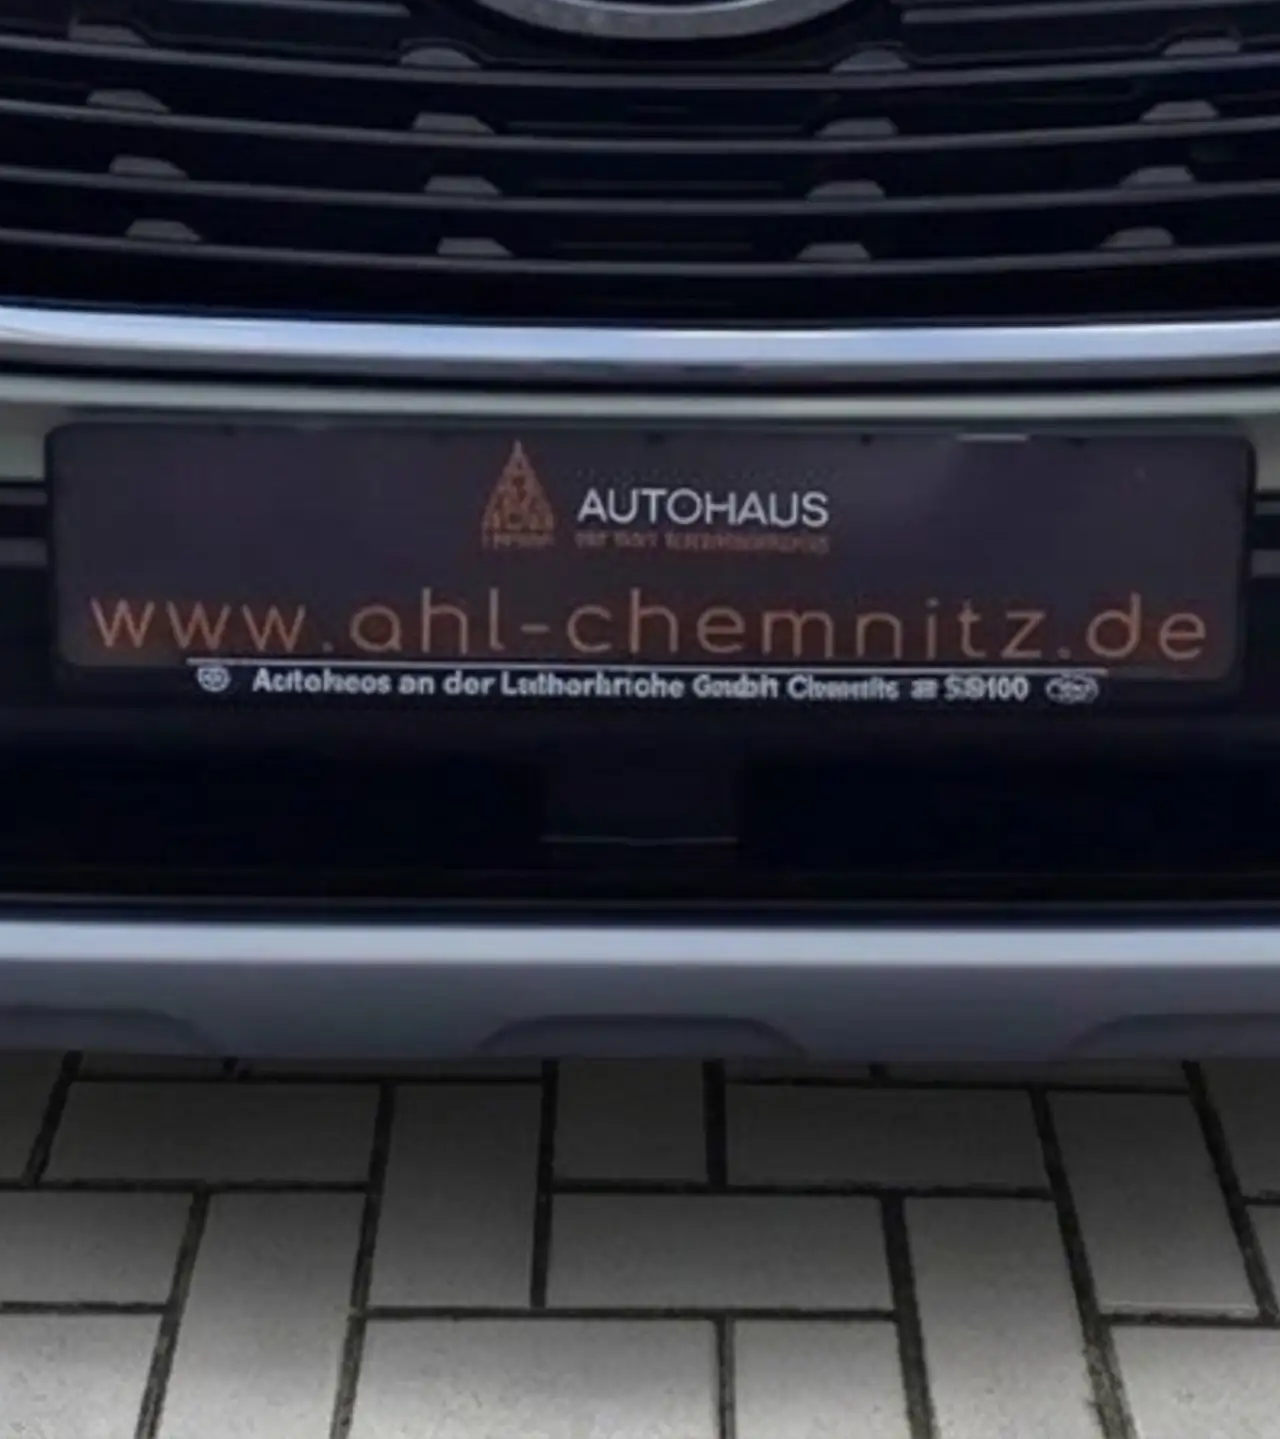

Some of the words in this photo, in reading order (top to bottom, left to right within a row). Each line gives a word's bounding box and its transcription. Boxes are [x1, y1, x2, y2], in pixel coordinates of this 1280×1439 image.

[577, 488, 829, 527] AUTOHAUS
[91, 588, 1207, 659] www.ahl-chemnitz.de
[398, 675, 435, 694] an
